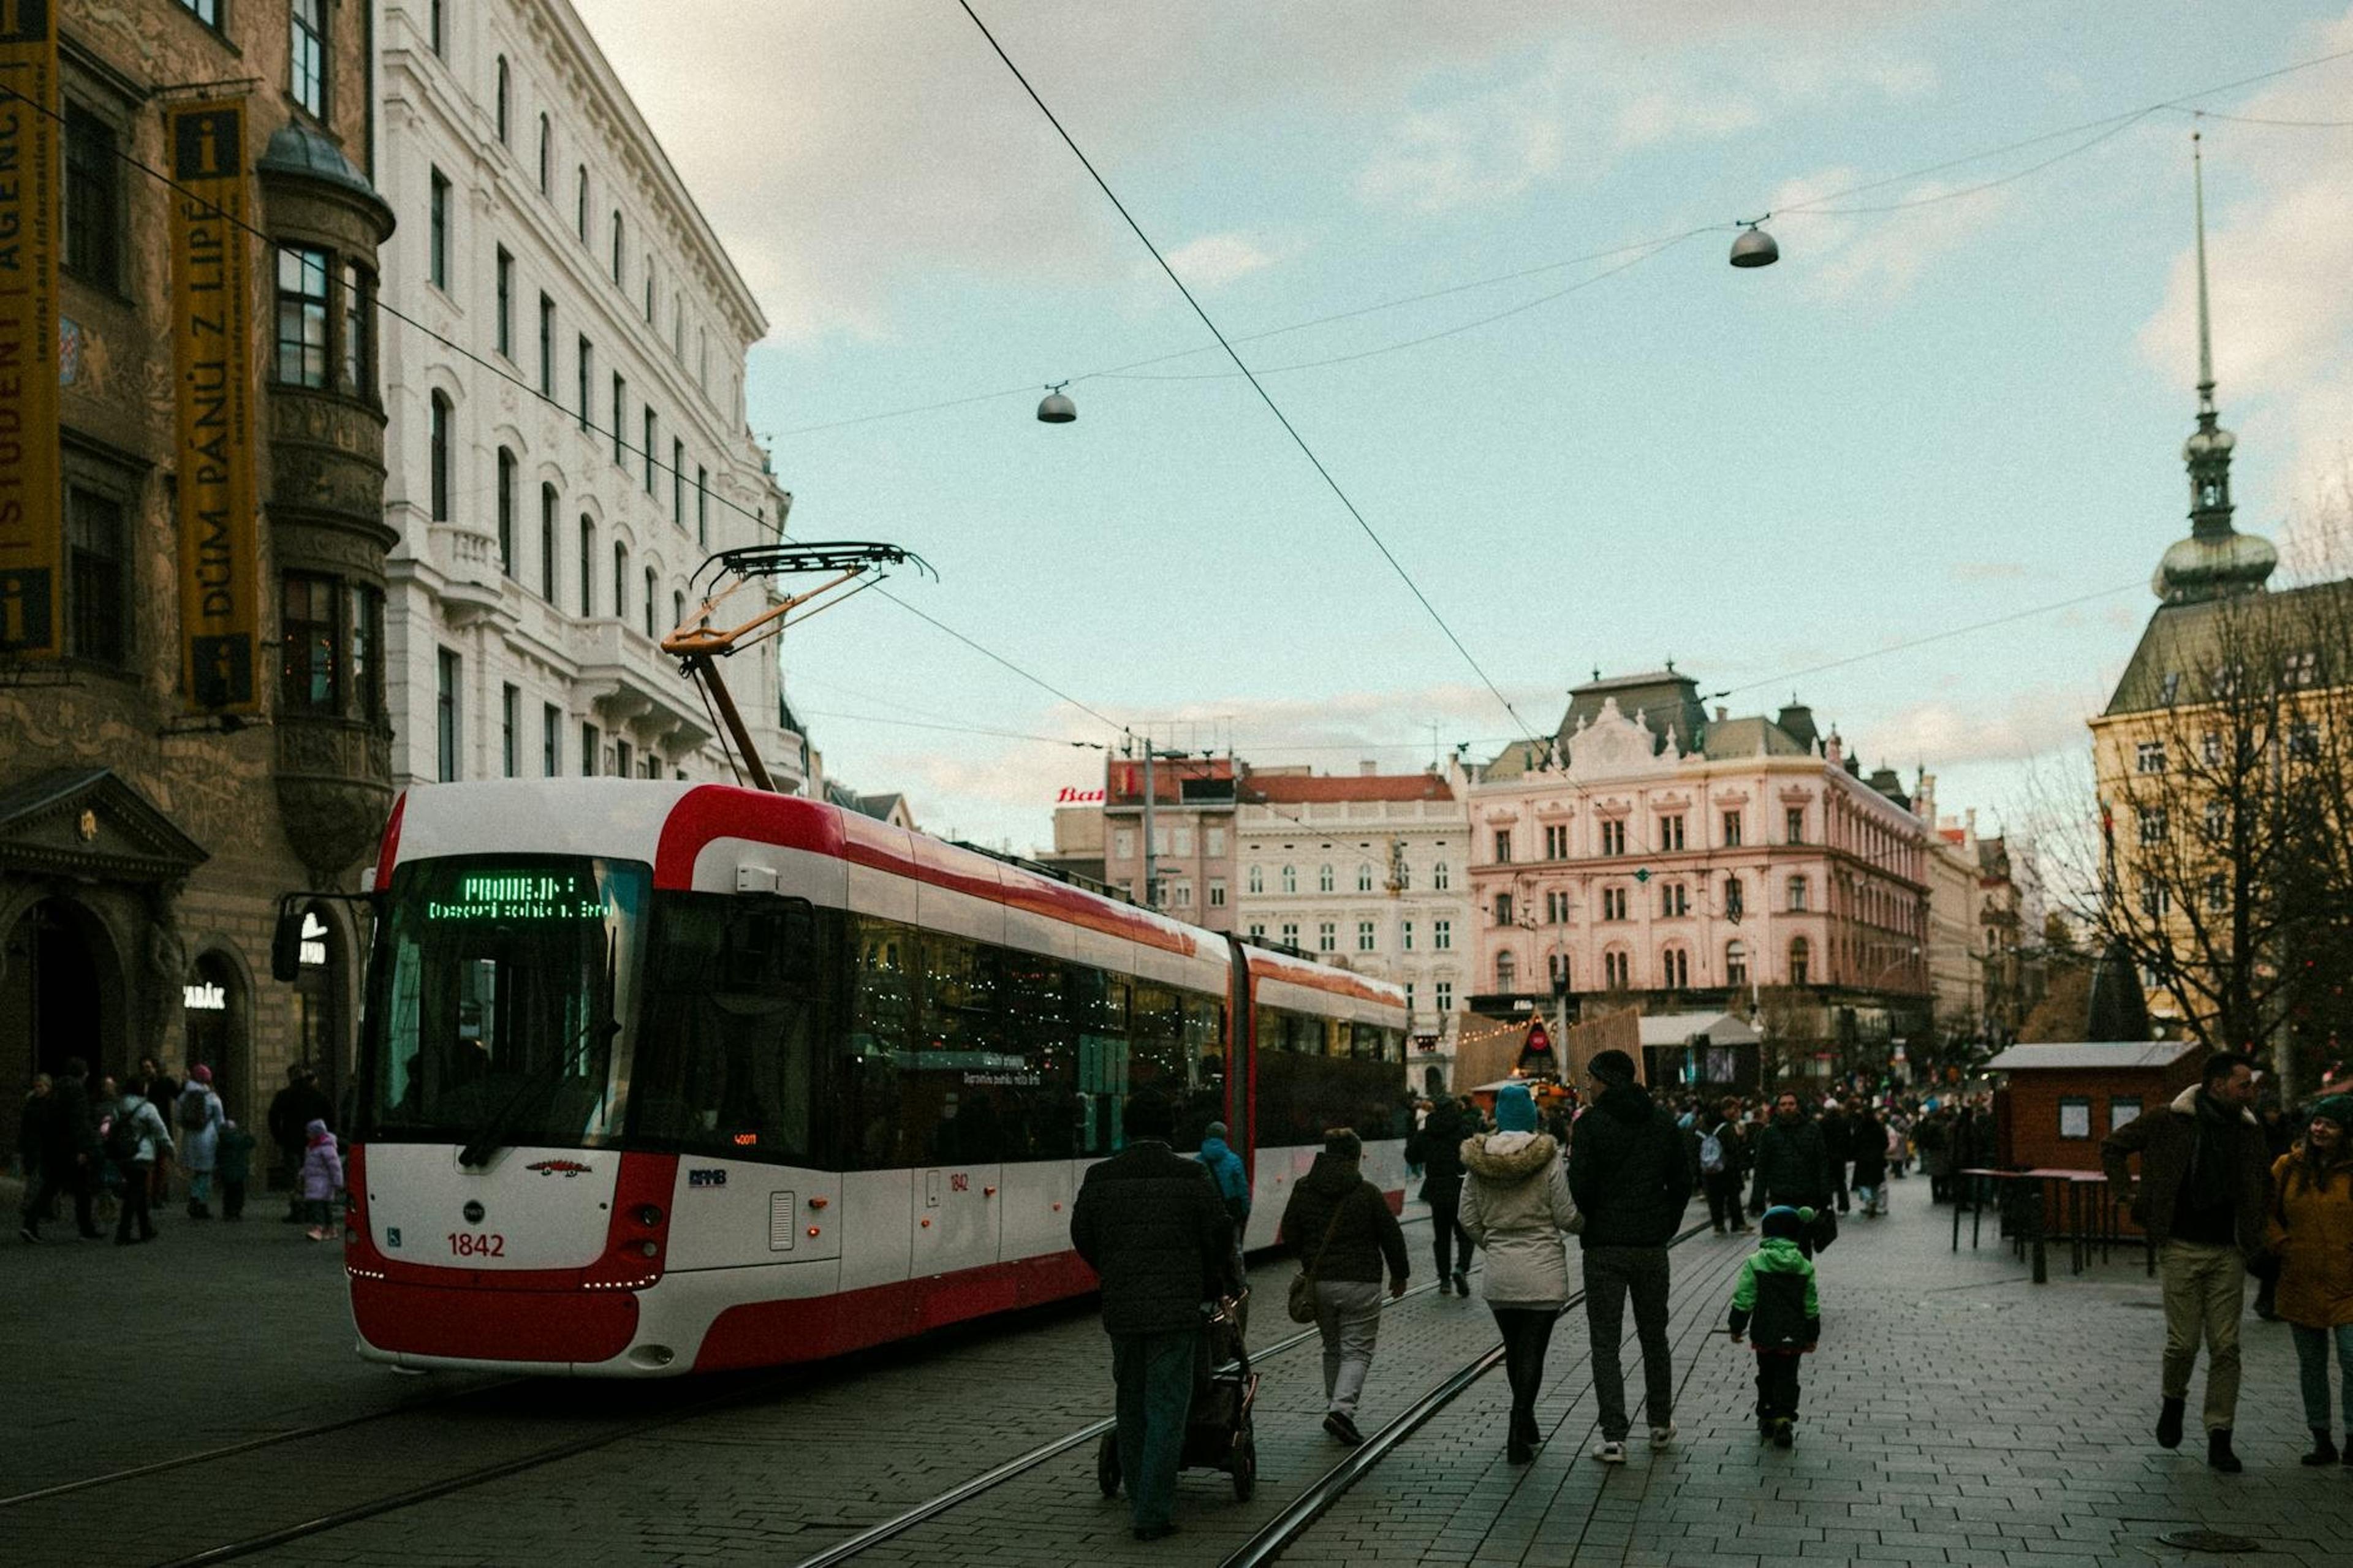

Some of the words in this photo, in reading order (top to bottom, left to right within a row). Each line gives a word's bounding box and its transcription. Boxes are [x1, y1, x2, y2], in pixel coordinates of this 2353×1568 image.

[181, 199, 224, 292] LIPÉ
[192, 311, 225, 337] Z
[186, 360, 230, 486] PÁNŮ
[196, 510, 233, 619] DŮM
[183, 982, 225, 1009] ABÁK
[448, 1233, 504, 1257] 1842
